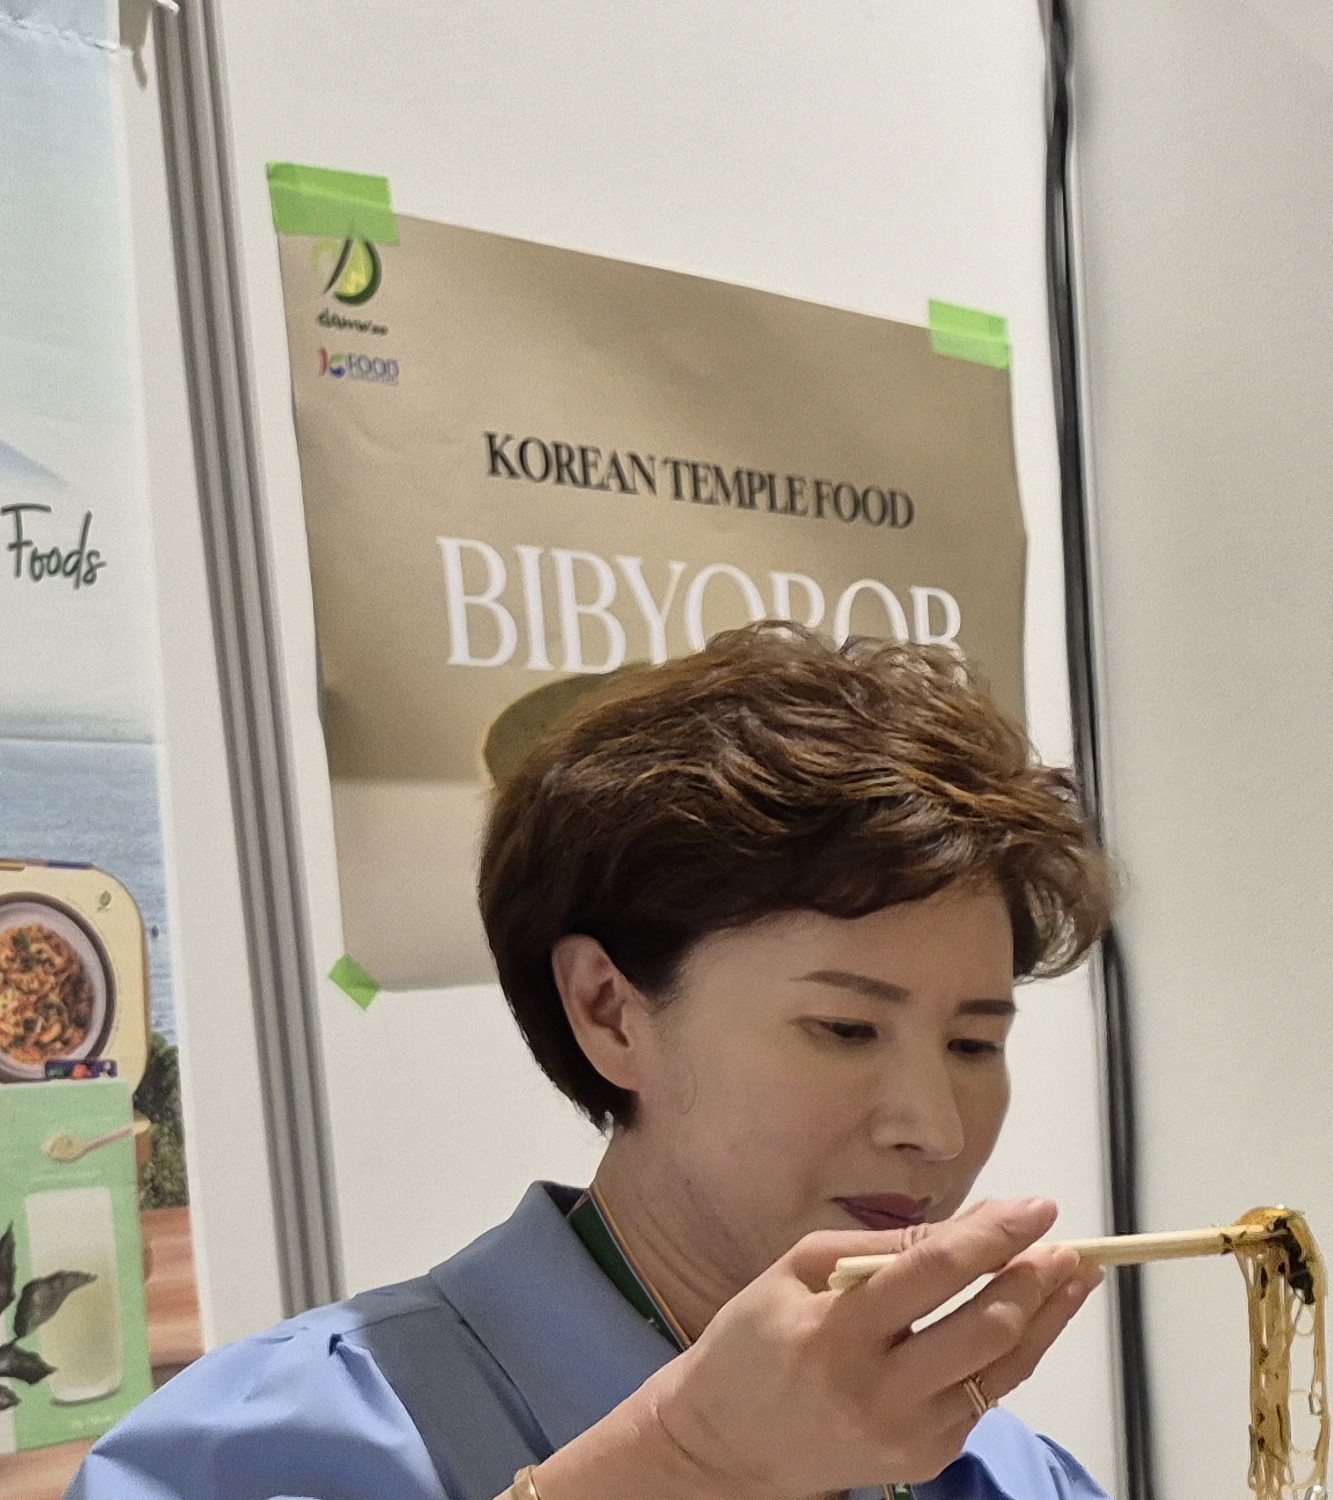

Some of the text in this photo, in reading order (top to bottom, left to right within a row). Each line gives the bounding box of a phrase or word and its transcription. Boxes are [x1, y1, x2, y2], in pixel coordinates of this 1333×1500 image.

[484, 431, 917, 530] KOREAN TEMPLE FOOD
[1, 503, 107, 590] Foods
